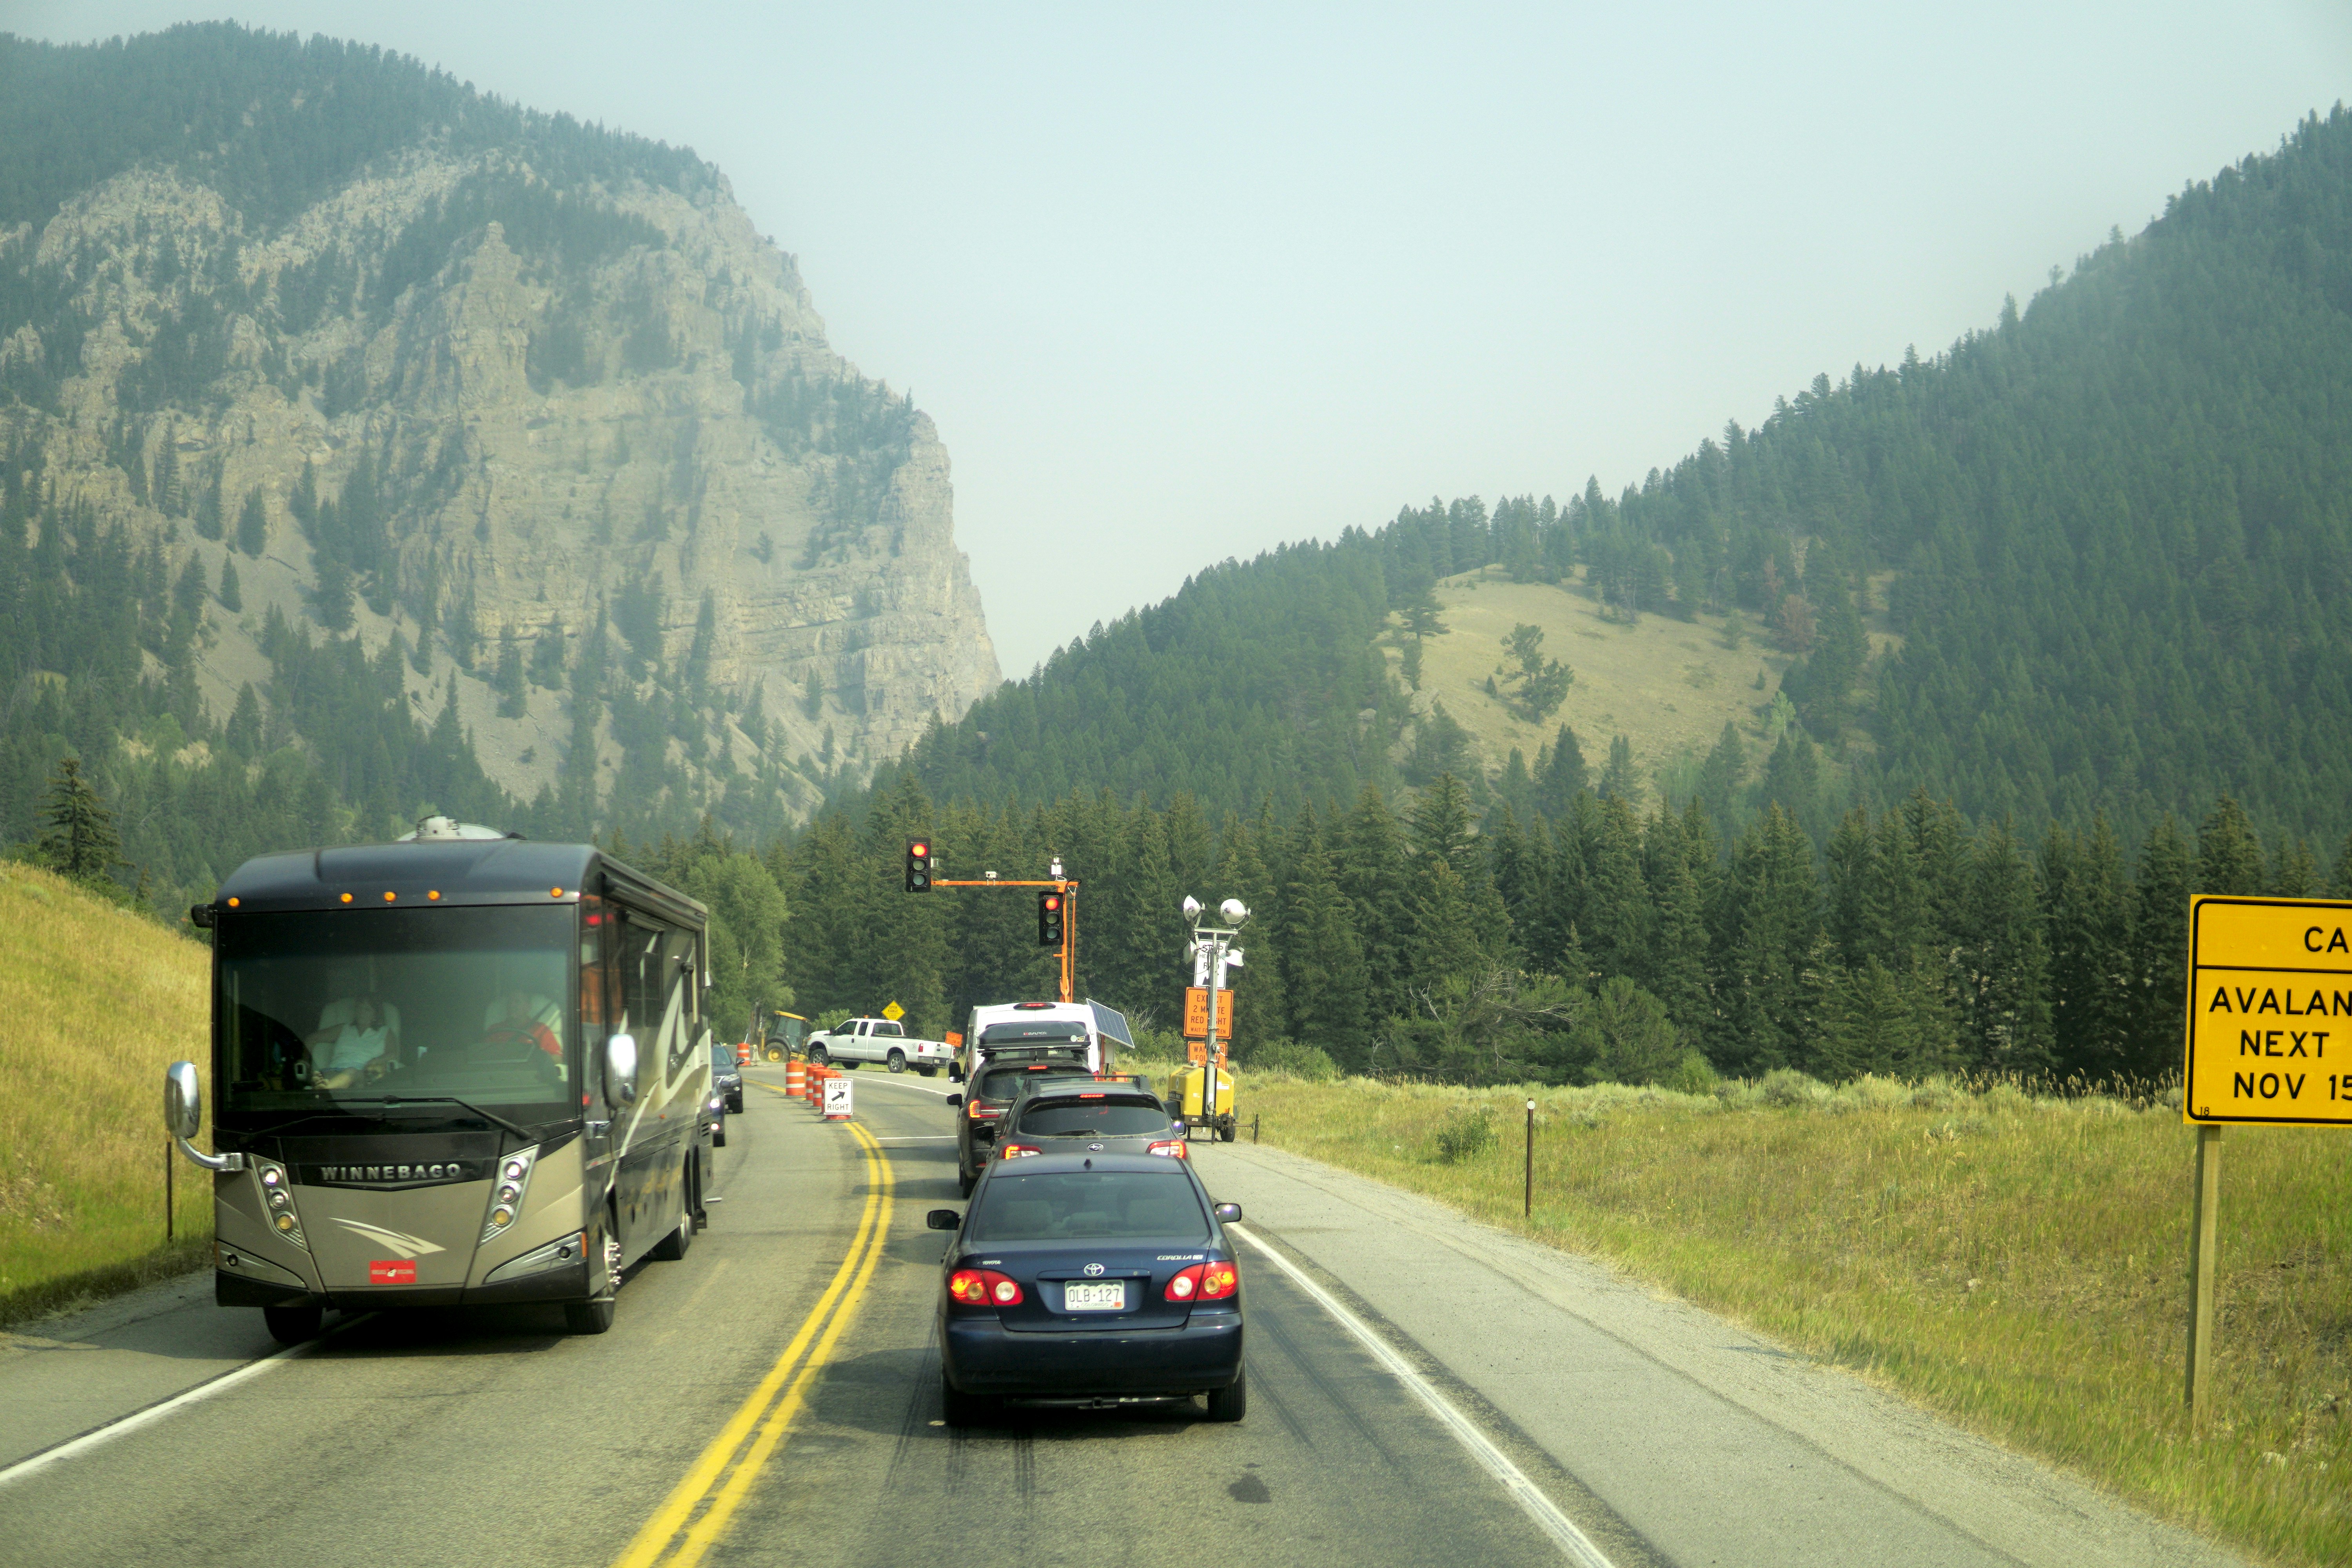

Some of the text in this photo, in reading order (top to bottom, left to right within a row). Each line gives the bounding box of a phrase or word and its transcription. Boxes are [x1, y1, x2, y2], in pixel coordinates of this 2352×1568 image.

[2304, 926, 2350, 953] CA
[2209, 986, 2352, 1016] AVALAN
[1191, 1016, 1204, 1024] RED
[2240, 1030, 2329, 1058] NEXT
[2234, 1072, 2306, 1099] NOV
[2200, 1106, 2210, 1116] 18
[321, 1163, 461, 1180] WINNEBAGO
